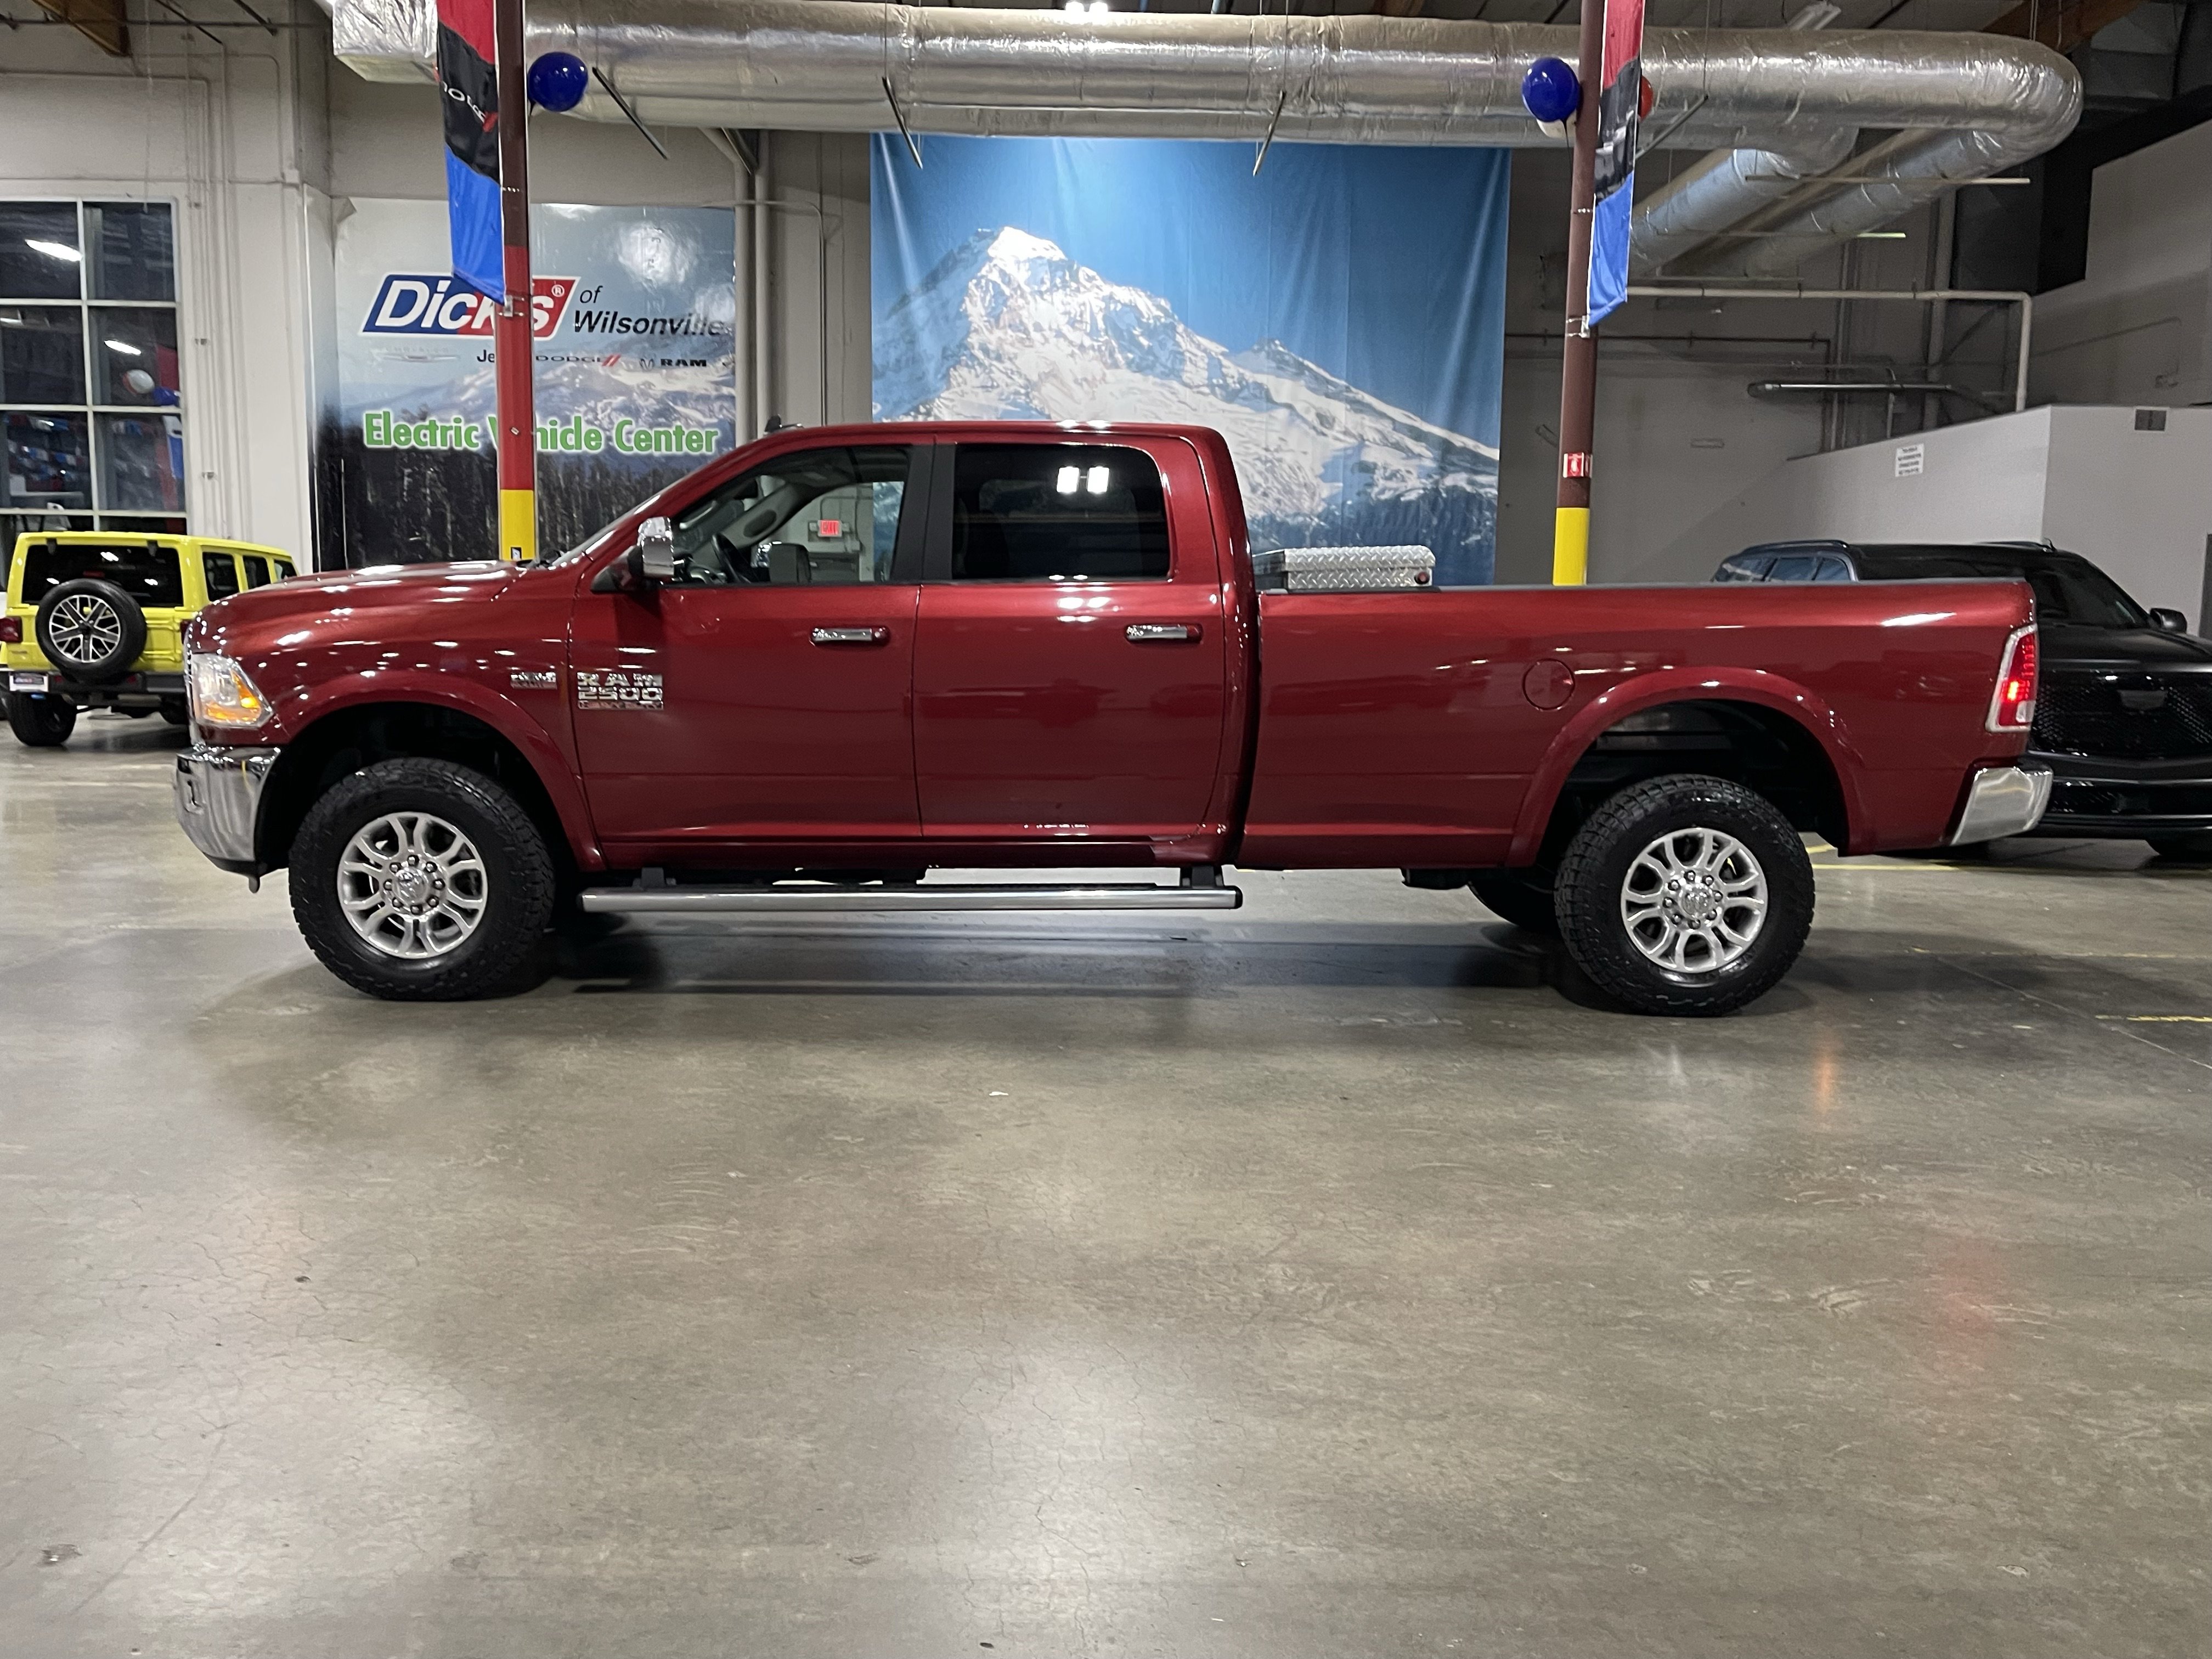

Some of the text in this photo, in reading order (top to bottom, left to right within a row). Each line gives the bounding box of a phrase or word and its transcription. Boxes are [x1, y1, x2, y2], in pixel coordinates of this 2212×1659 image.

[579, 285, 603, 303] of
[476, 349, 495, 363] Je
[661, 358, 707, 367] RAM
[365, 411, 718, 452] Electric Vhicle Center
[577, 672, 662, 686] RAM
[578, 686, 663, 701] 2500
